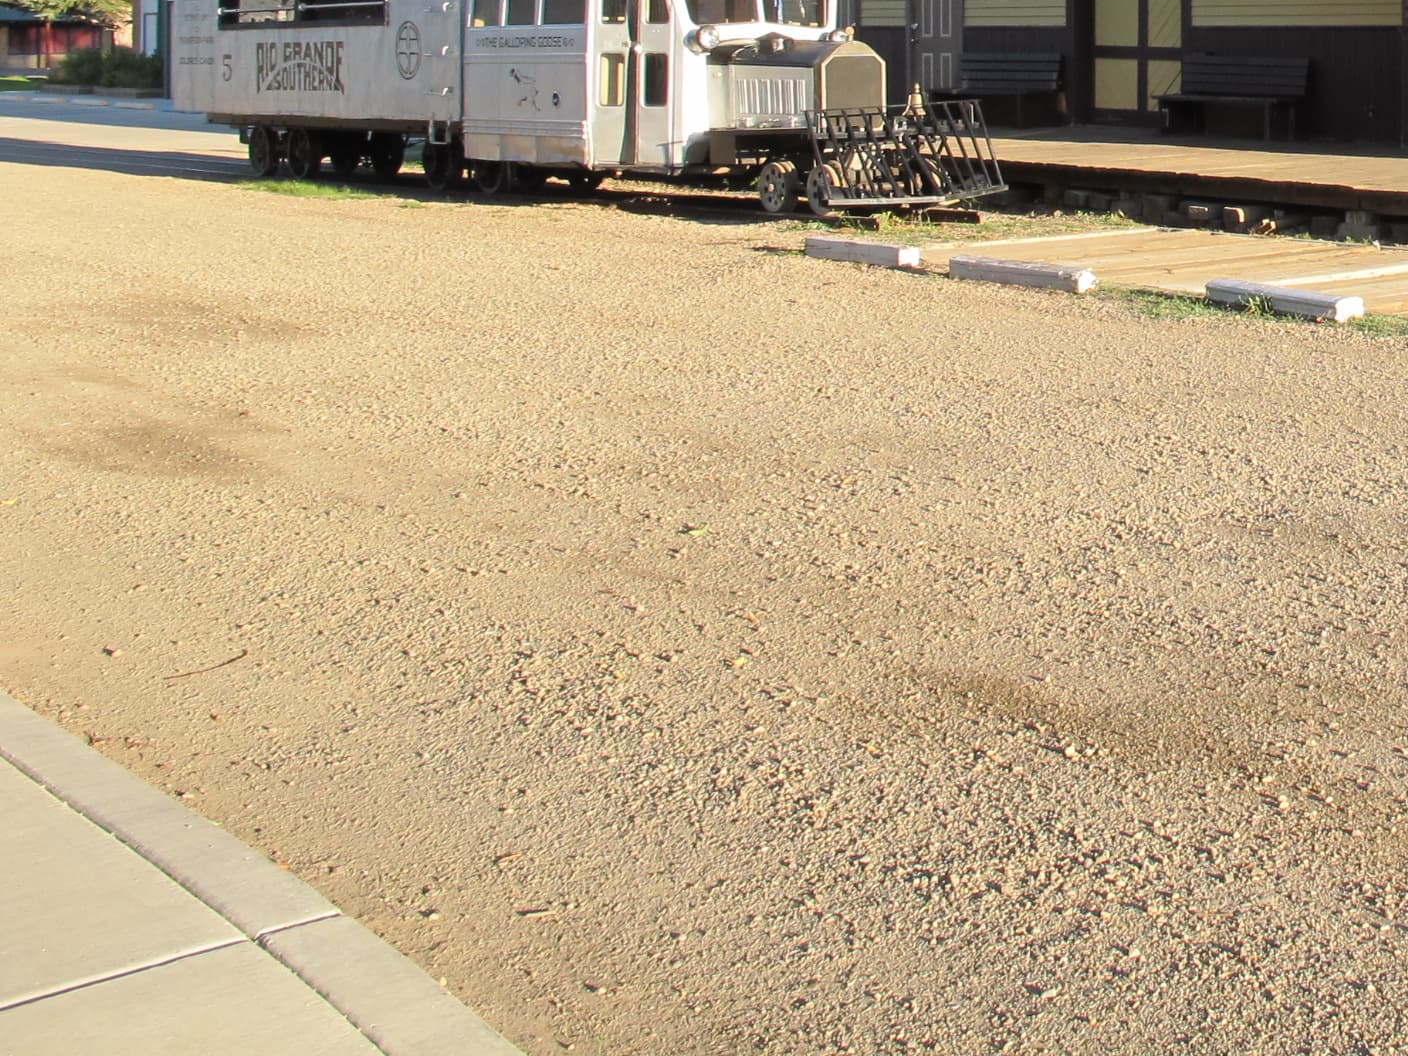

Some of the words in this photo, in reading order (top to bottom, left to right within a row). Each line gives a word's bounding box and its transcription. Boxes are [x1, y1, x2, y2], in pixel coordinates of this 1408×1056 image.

[498, 36, 536, 48] GALLOPING
[537, 36, 563, 48] GOOSE
[222, 54, 233, 82] 5
[256, 41, 277, 95] RIO
[283, 41, 345, 95] GRANDE
[273, 62, 334, 92] SOUTHERN
